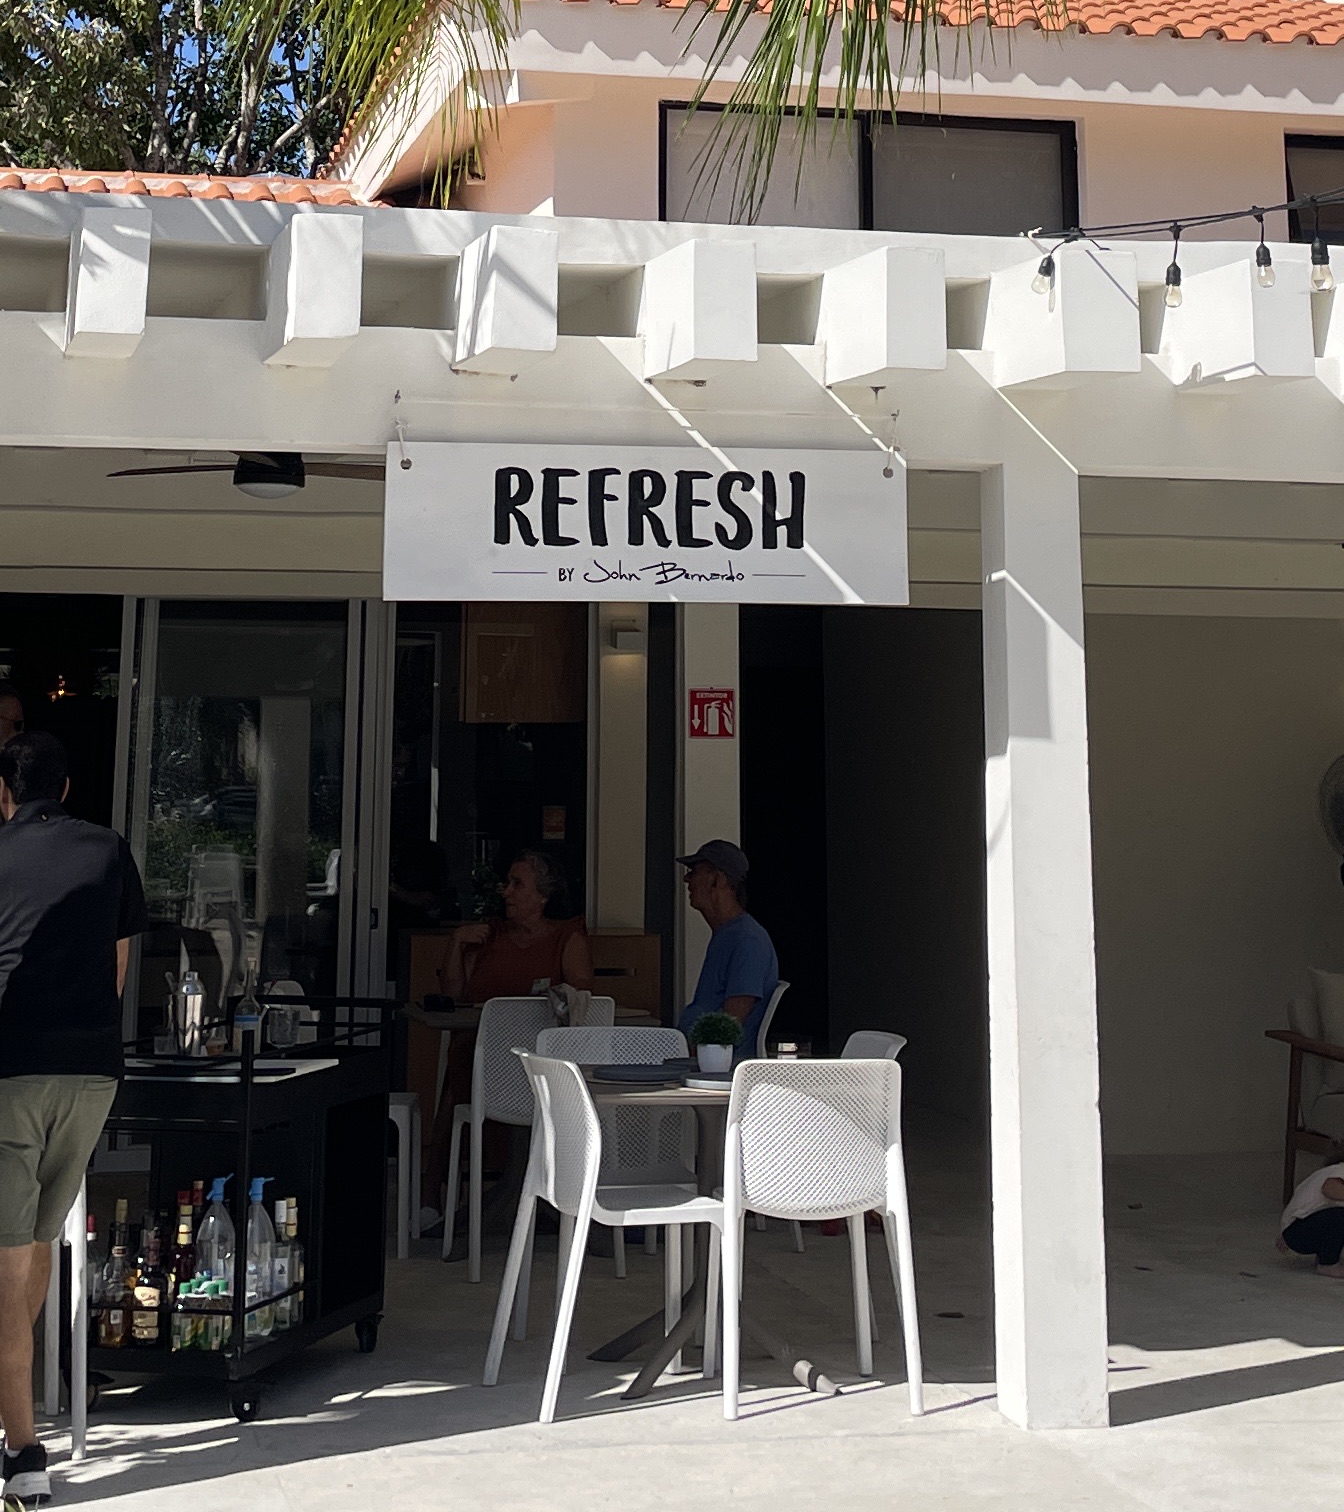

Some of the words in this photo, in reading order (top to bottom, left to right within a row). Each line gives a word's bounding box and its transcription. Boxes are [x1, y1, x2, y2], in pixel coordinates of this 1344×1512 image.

[493, 467, 805, 550] REFRESH
[558, 567, 575, 582] BY
[583, 560, 641, 583] John
